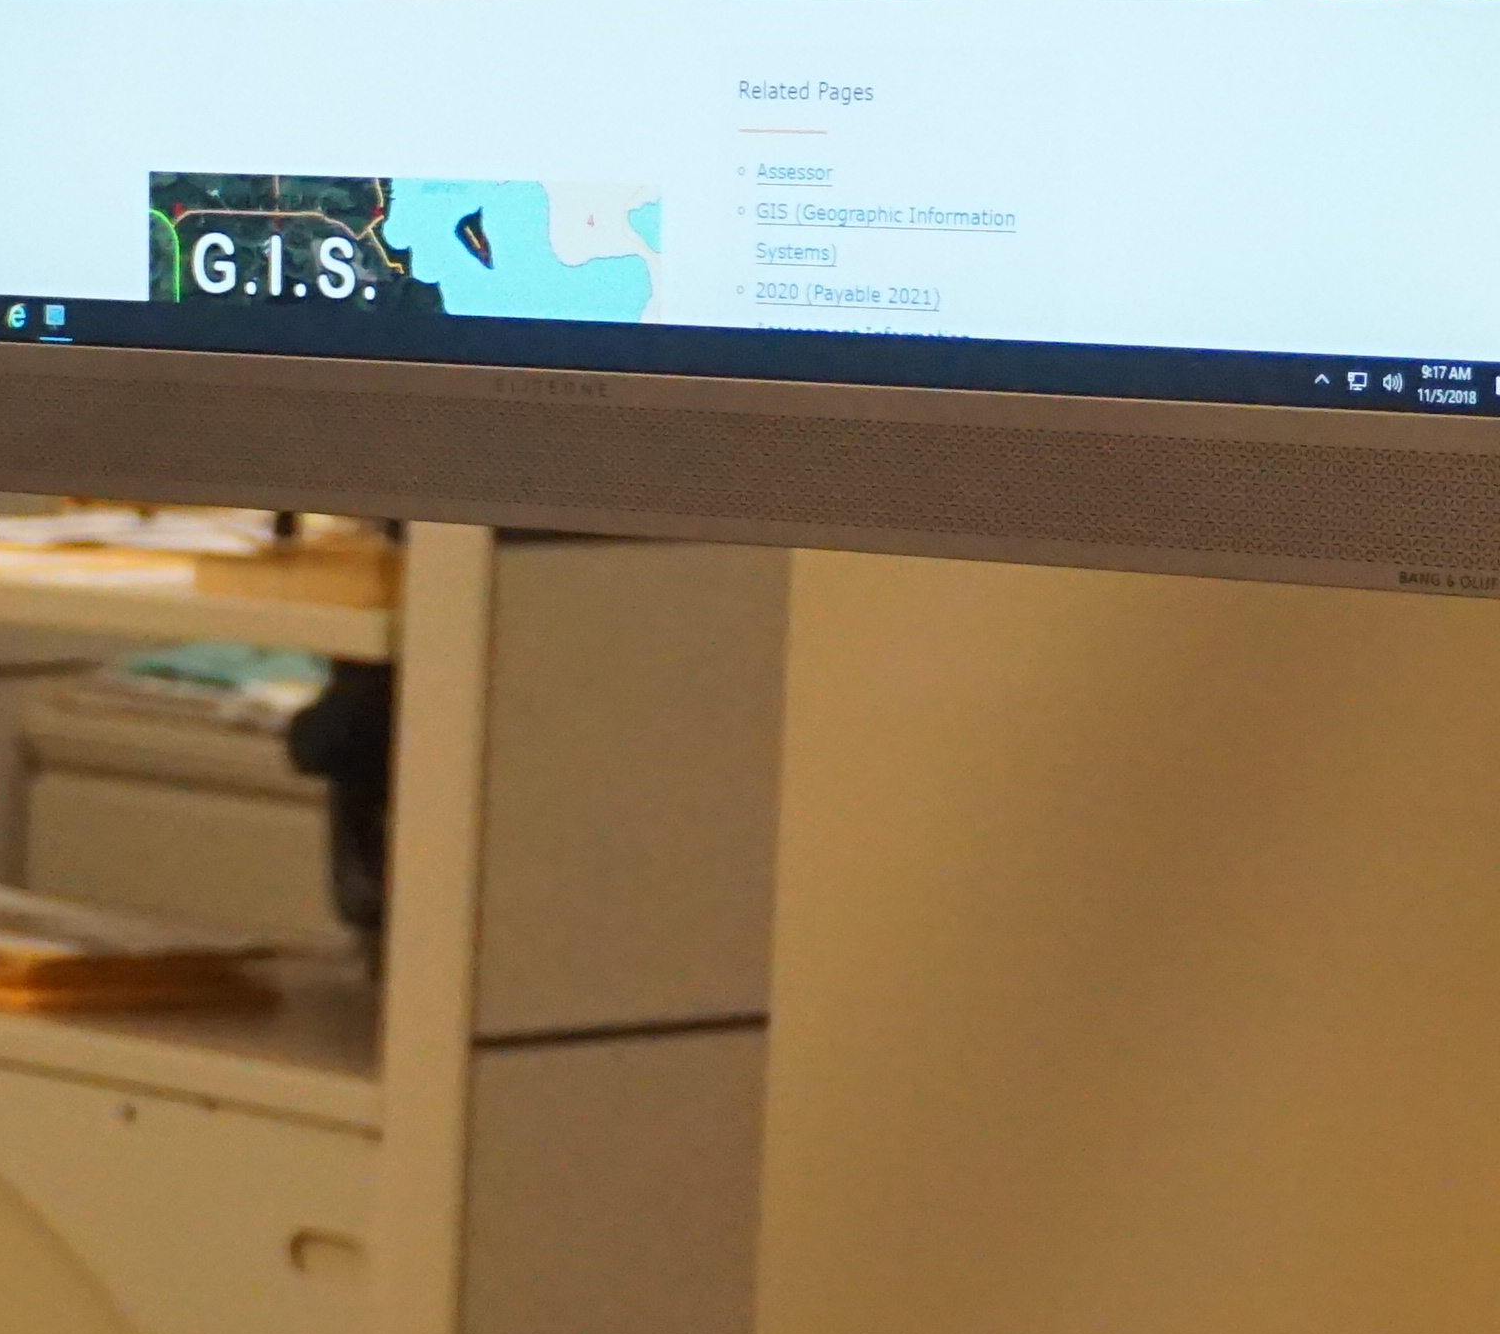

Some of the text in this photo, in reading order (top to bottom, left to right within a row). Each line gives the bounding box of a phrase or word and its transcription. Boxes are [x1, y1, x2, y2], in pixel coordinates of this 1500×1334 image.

[738, 80, 875, 106] Related Pages
[757, 162, 834, 181] Assessor
[587, 214, 596, 229] 4
[756, 202, 1016, 228] GIS (Geographic Information
[756, 242, 838, 266] Systems)
[192, 231, 377, 301] G.I.S.
[756, 282, 940, 310] 2020 (Payable 2021)
[1421, 364, 1472, 381] 9:17 AM
[1417, 387, 1477, 405] 11/5/2018
[1399, 570, 1440, 587] BANG
